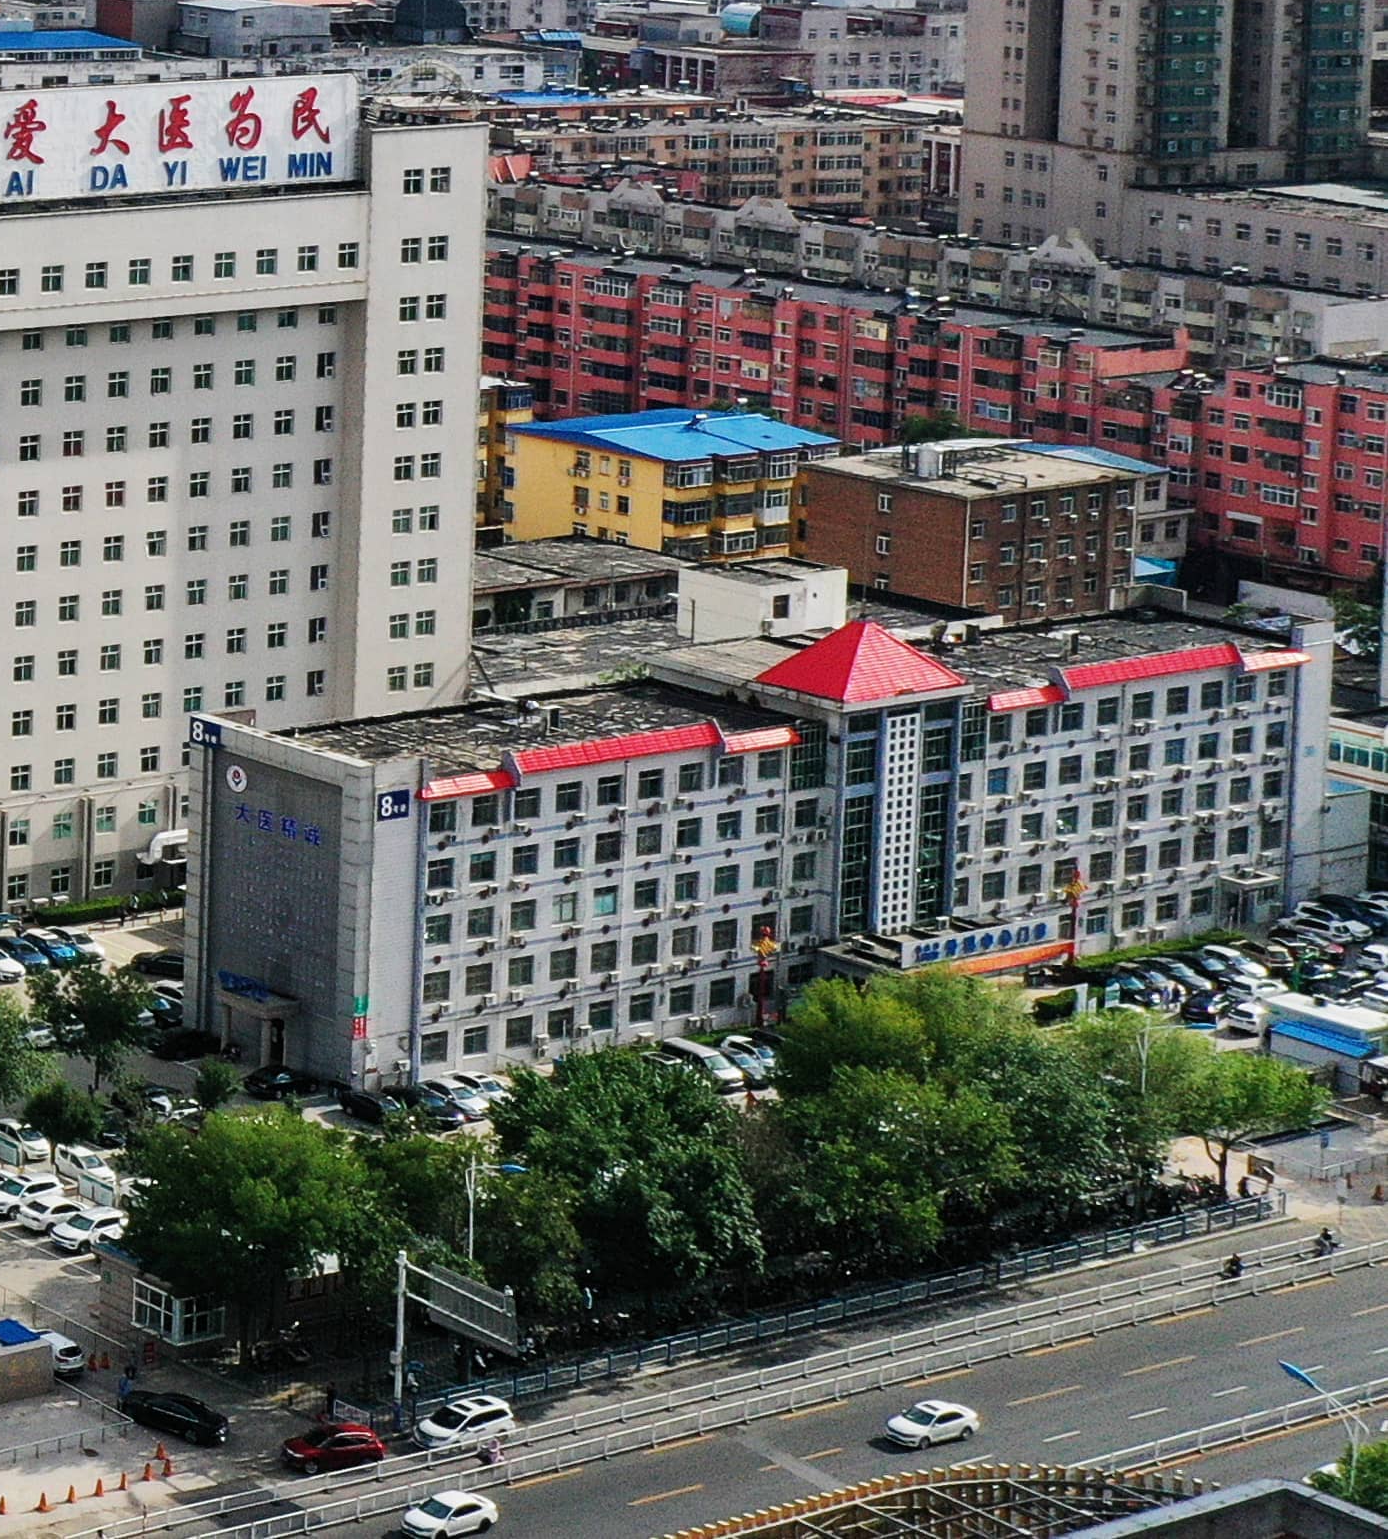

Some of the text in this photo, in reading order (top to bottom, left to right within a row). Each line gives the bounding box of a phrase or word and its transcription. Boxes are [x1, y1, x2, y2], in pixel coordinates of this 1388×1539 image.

[6, 170, 33, 196] AI
[91, 164, 128, 192] DA
[164, 161, 187, 186] YI
[219, 155, 266, 182] WEI
[288, 152, 331, 178] MIN
